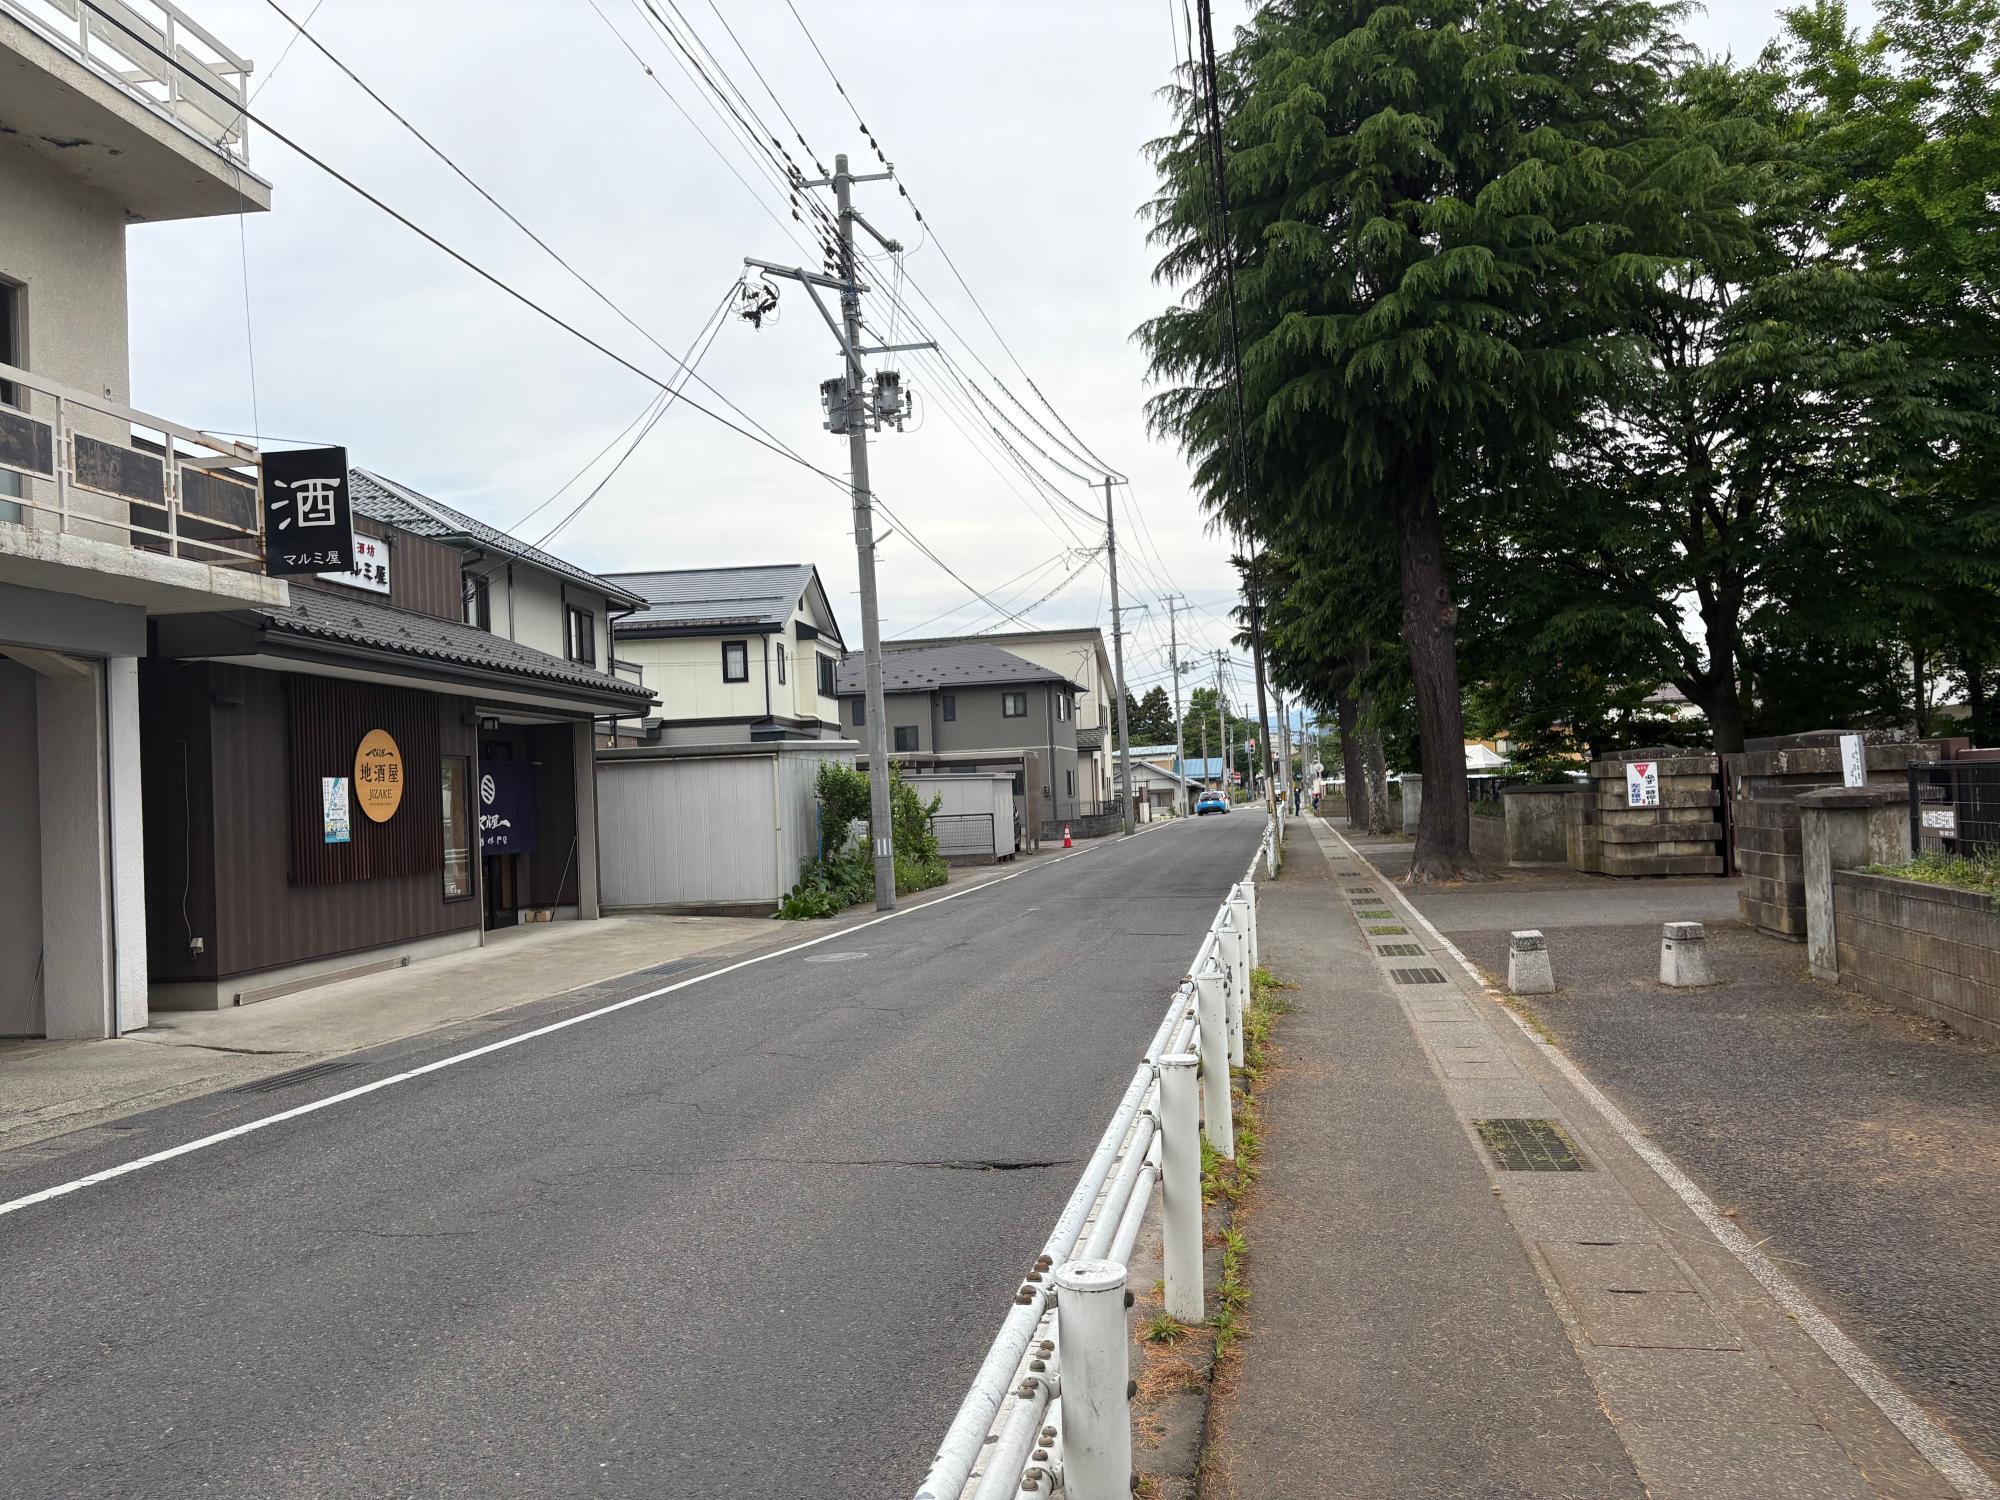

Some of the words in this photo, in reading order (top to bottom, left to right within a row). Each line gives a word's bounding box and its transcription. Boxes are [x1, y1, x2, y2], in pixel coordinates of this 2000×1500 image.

[270, 477, 341, 531] 酒
[283, 550, 342, 566] マルミ屋
[350, 561, 388, 585] ルミ屋
[359, 762, 399, 783] 地酒屋
[368, 788, 393, 800] JIZAKE
[1645, 774, 1657, 805] 必ず一時停止
